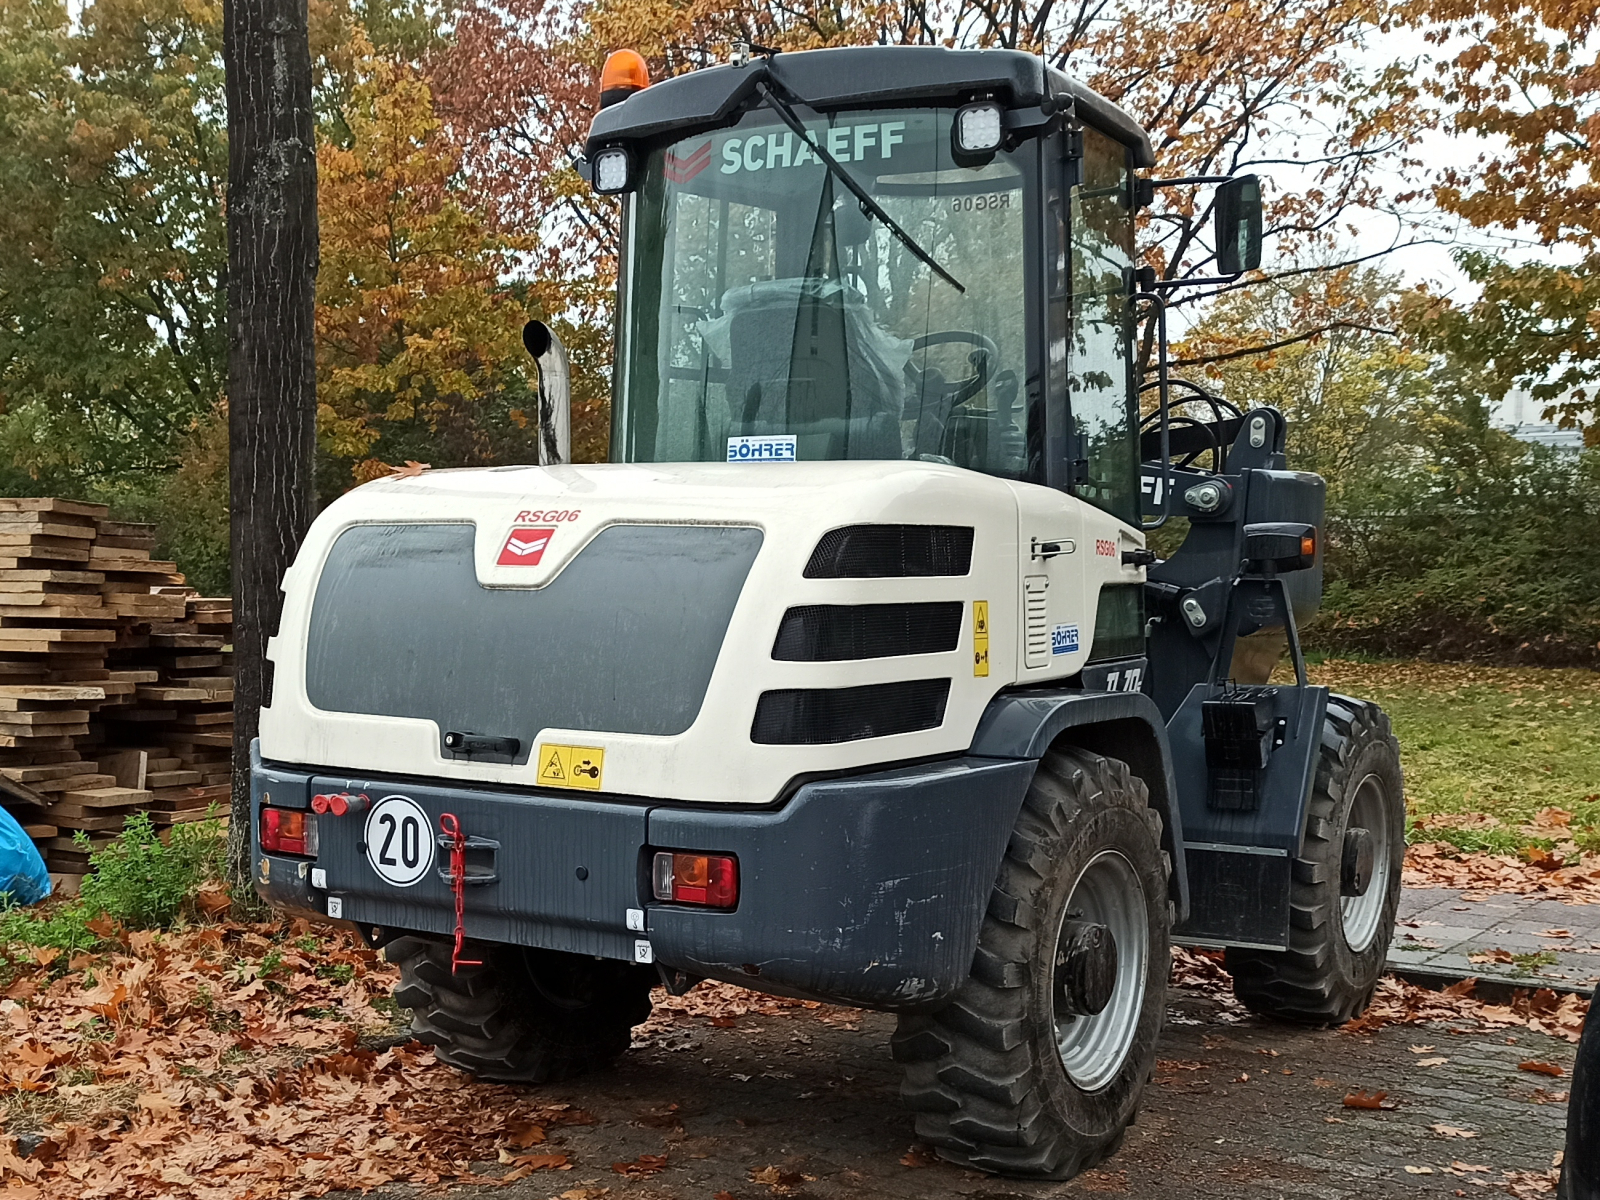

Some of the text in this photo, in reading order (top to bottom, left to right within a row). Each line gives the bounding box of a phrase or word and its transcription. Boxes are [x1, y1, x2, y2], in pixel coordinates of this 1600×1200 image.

[720, 121, 906, 175] SCHAEFF
[513, 510, 581, 522] RSG06
[1096, 539, 1115, 557] RSG06
[379, 813, 419, 869] 20
